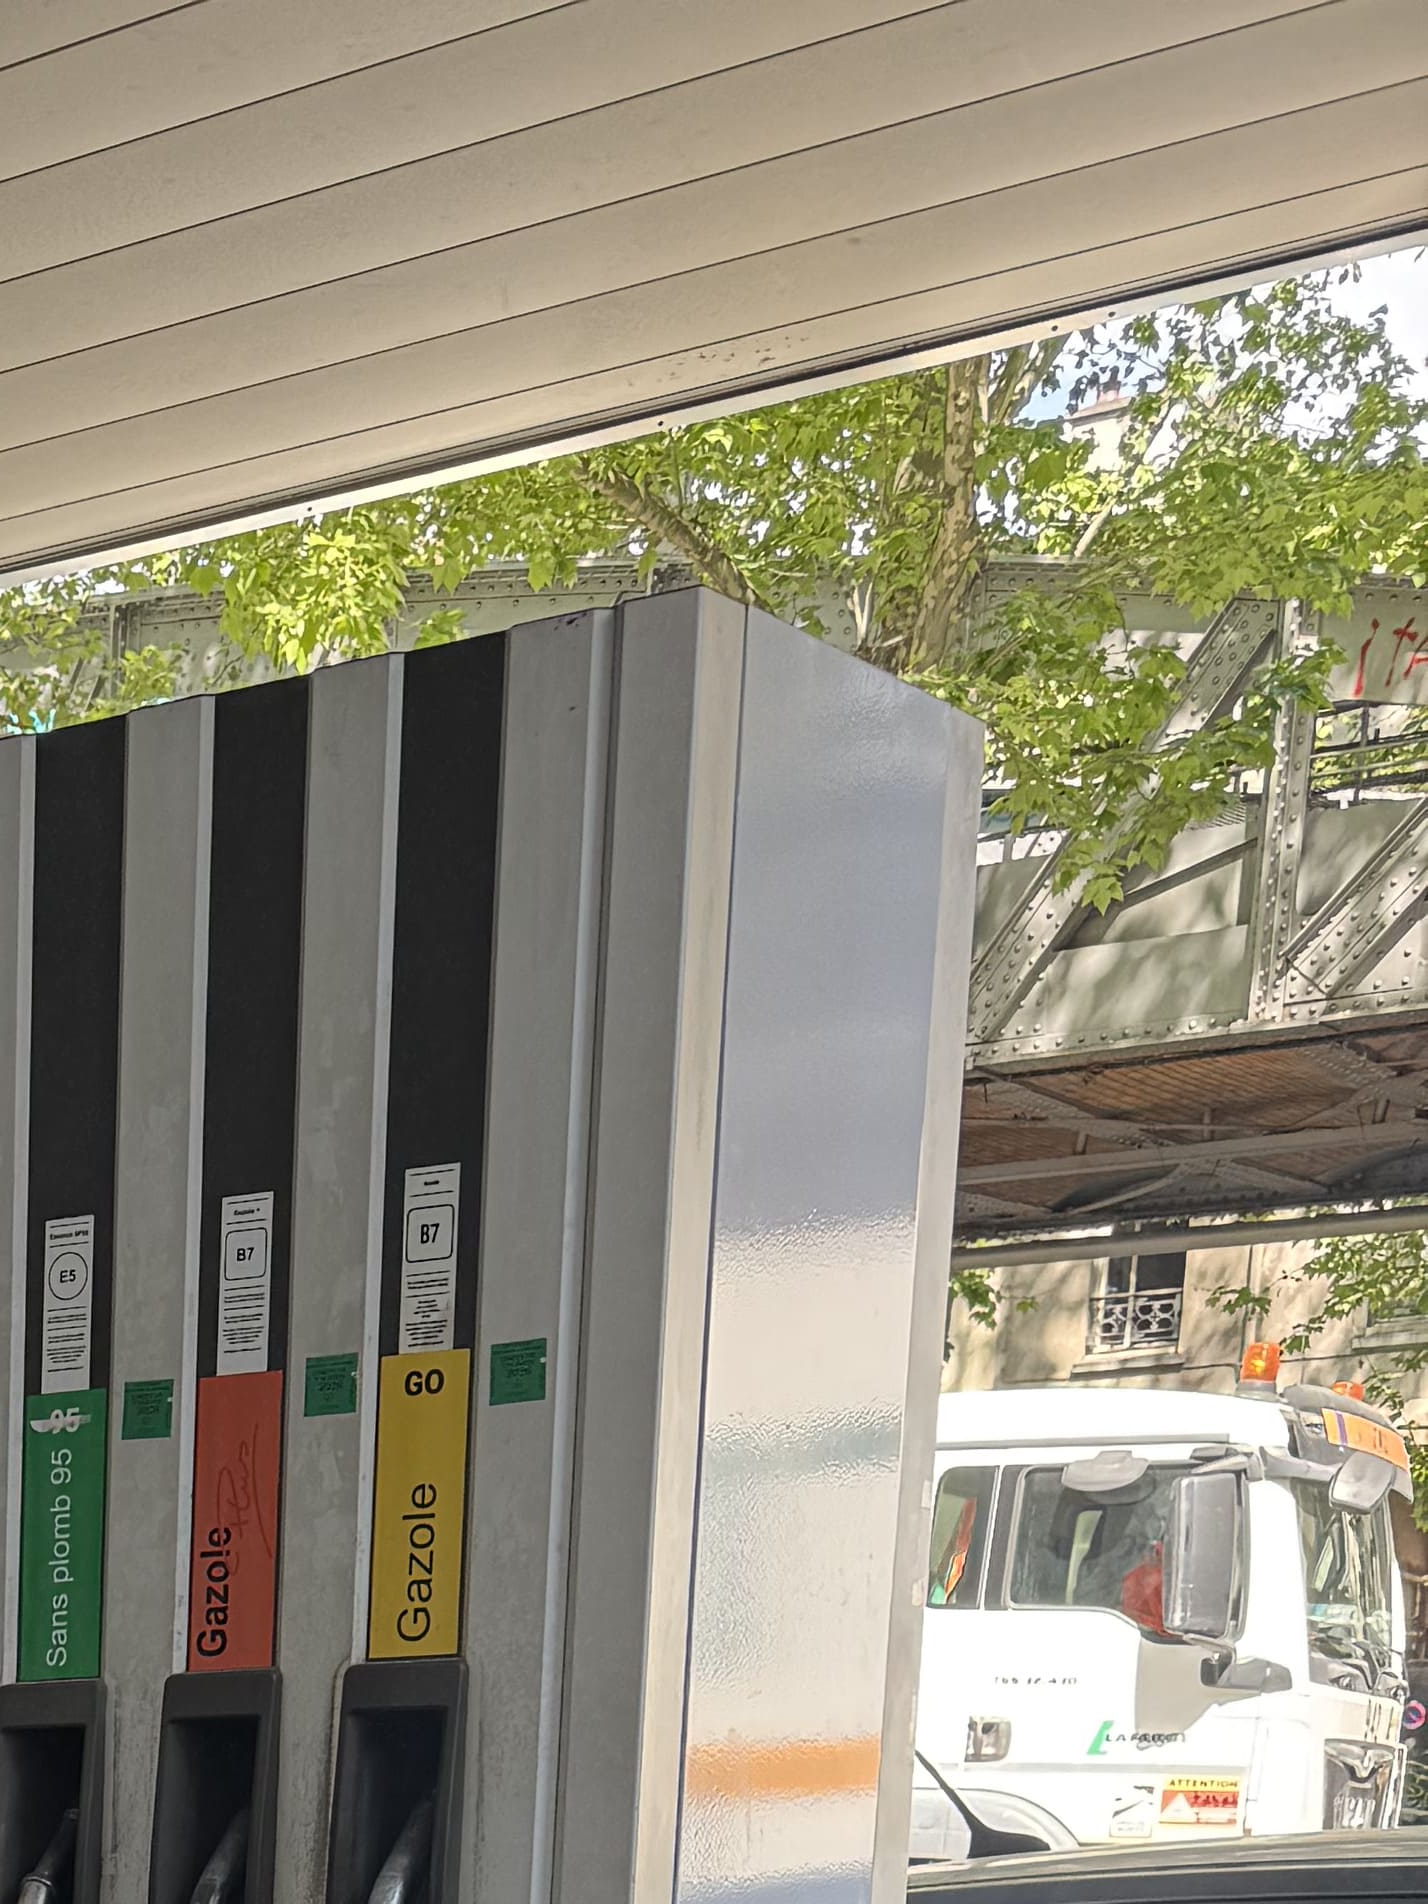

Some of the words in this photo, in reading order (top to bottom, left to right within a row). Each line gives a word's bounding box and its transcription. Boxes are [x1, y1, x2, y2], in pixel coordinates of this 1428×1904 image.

[420, 1223, 440, 1244] B7
[236, 1247, 255, 1261] B7
[59, 1269, 76, 1283] E5
[404, 1369, 444, 1396] GO
[50, 1448, 72, 1485] 95
[48, 1495, 74, 1583] plomb
[397, 1483, 437, 1642] Gazole
[196, 1527, 232, 1657] Gazole
[46, 1594, 68, 1667] Sans
